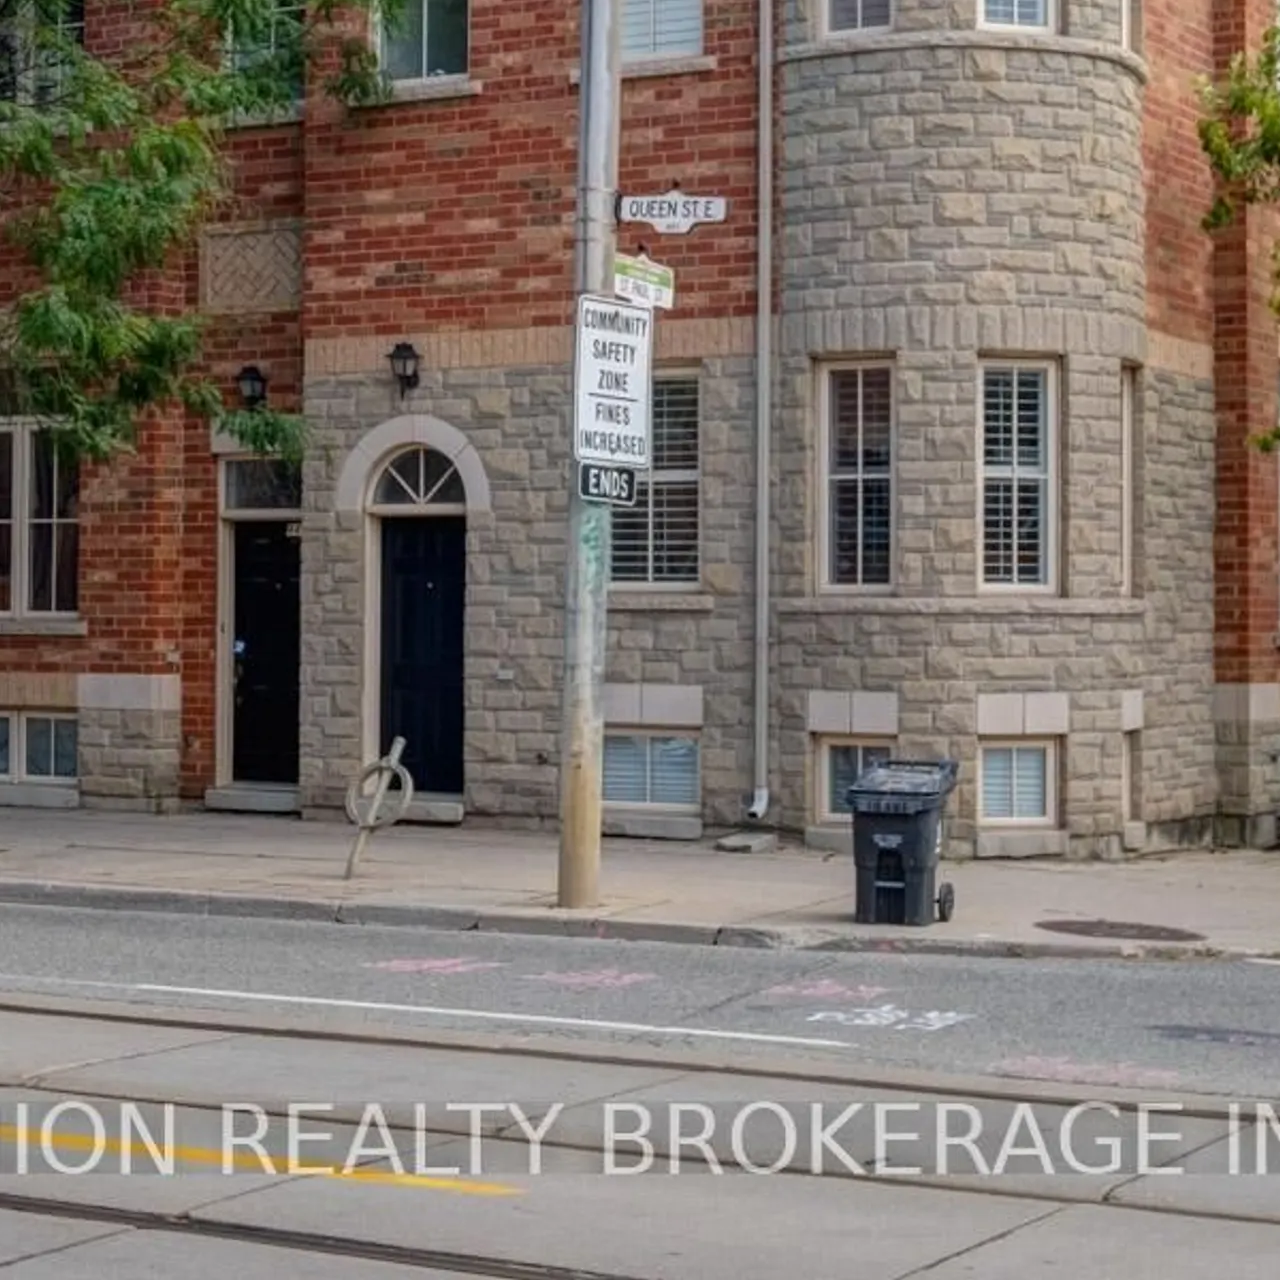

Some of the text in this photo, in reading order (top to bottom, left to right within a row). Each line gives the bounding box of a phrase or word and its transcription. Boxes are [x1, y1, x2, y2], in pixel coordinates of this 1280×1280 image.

[629, 200, 715, 218] QUEEN ST E
[584, 307, 648, 337] COMMUNITY
[592, 338, 636, 365] SAFETY
[597, 368, 629, 393] ZONE
[595, 402, 631, 426] FINES
[579, 428, 646, 455] INCREASED
[588, 468, 630, 498] ENDS
